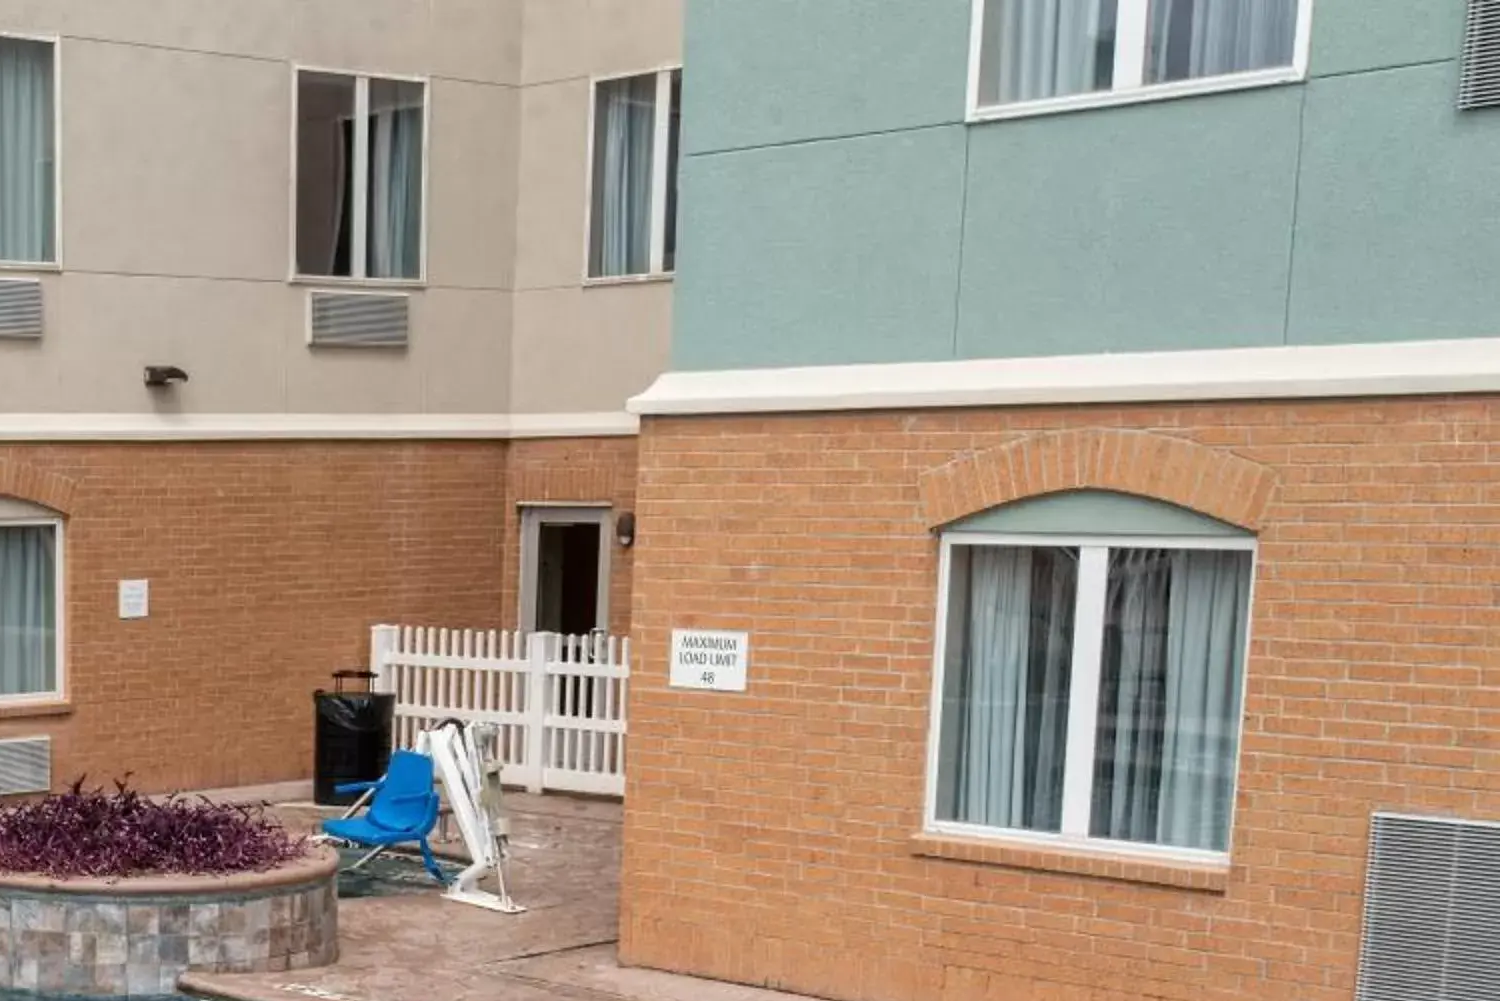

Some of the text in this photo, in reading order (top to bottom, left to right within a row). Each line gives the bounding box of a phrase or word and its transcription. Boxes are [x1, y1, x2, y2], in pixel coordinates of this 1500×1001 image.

[681, 635, 737, 650] MAXIMUM
[679, 651, 737, 667] LOAD LIMIT
